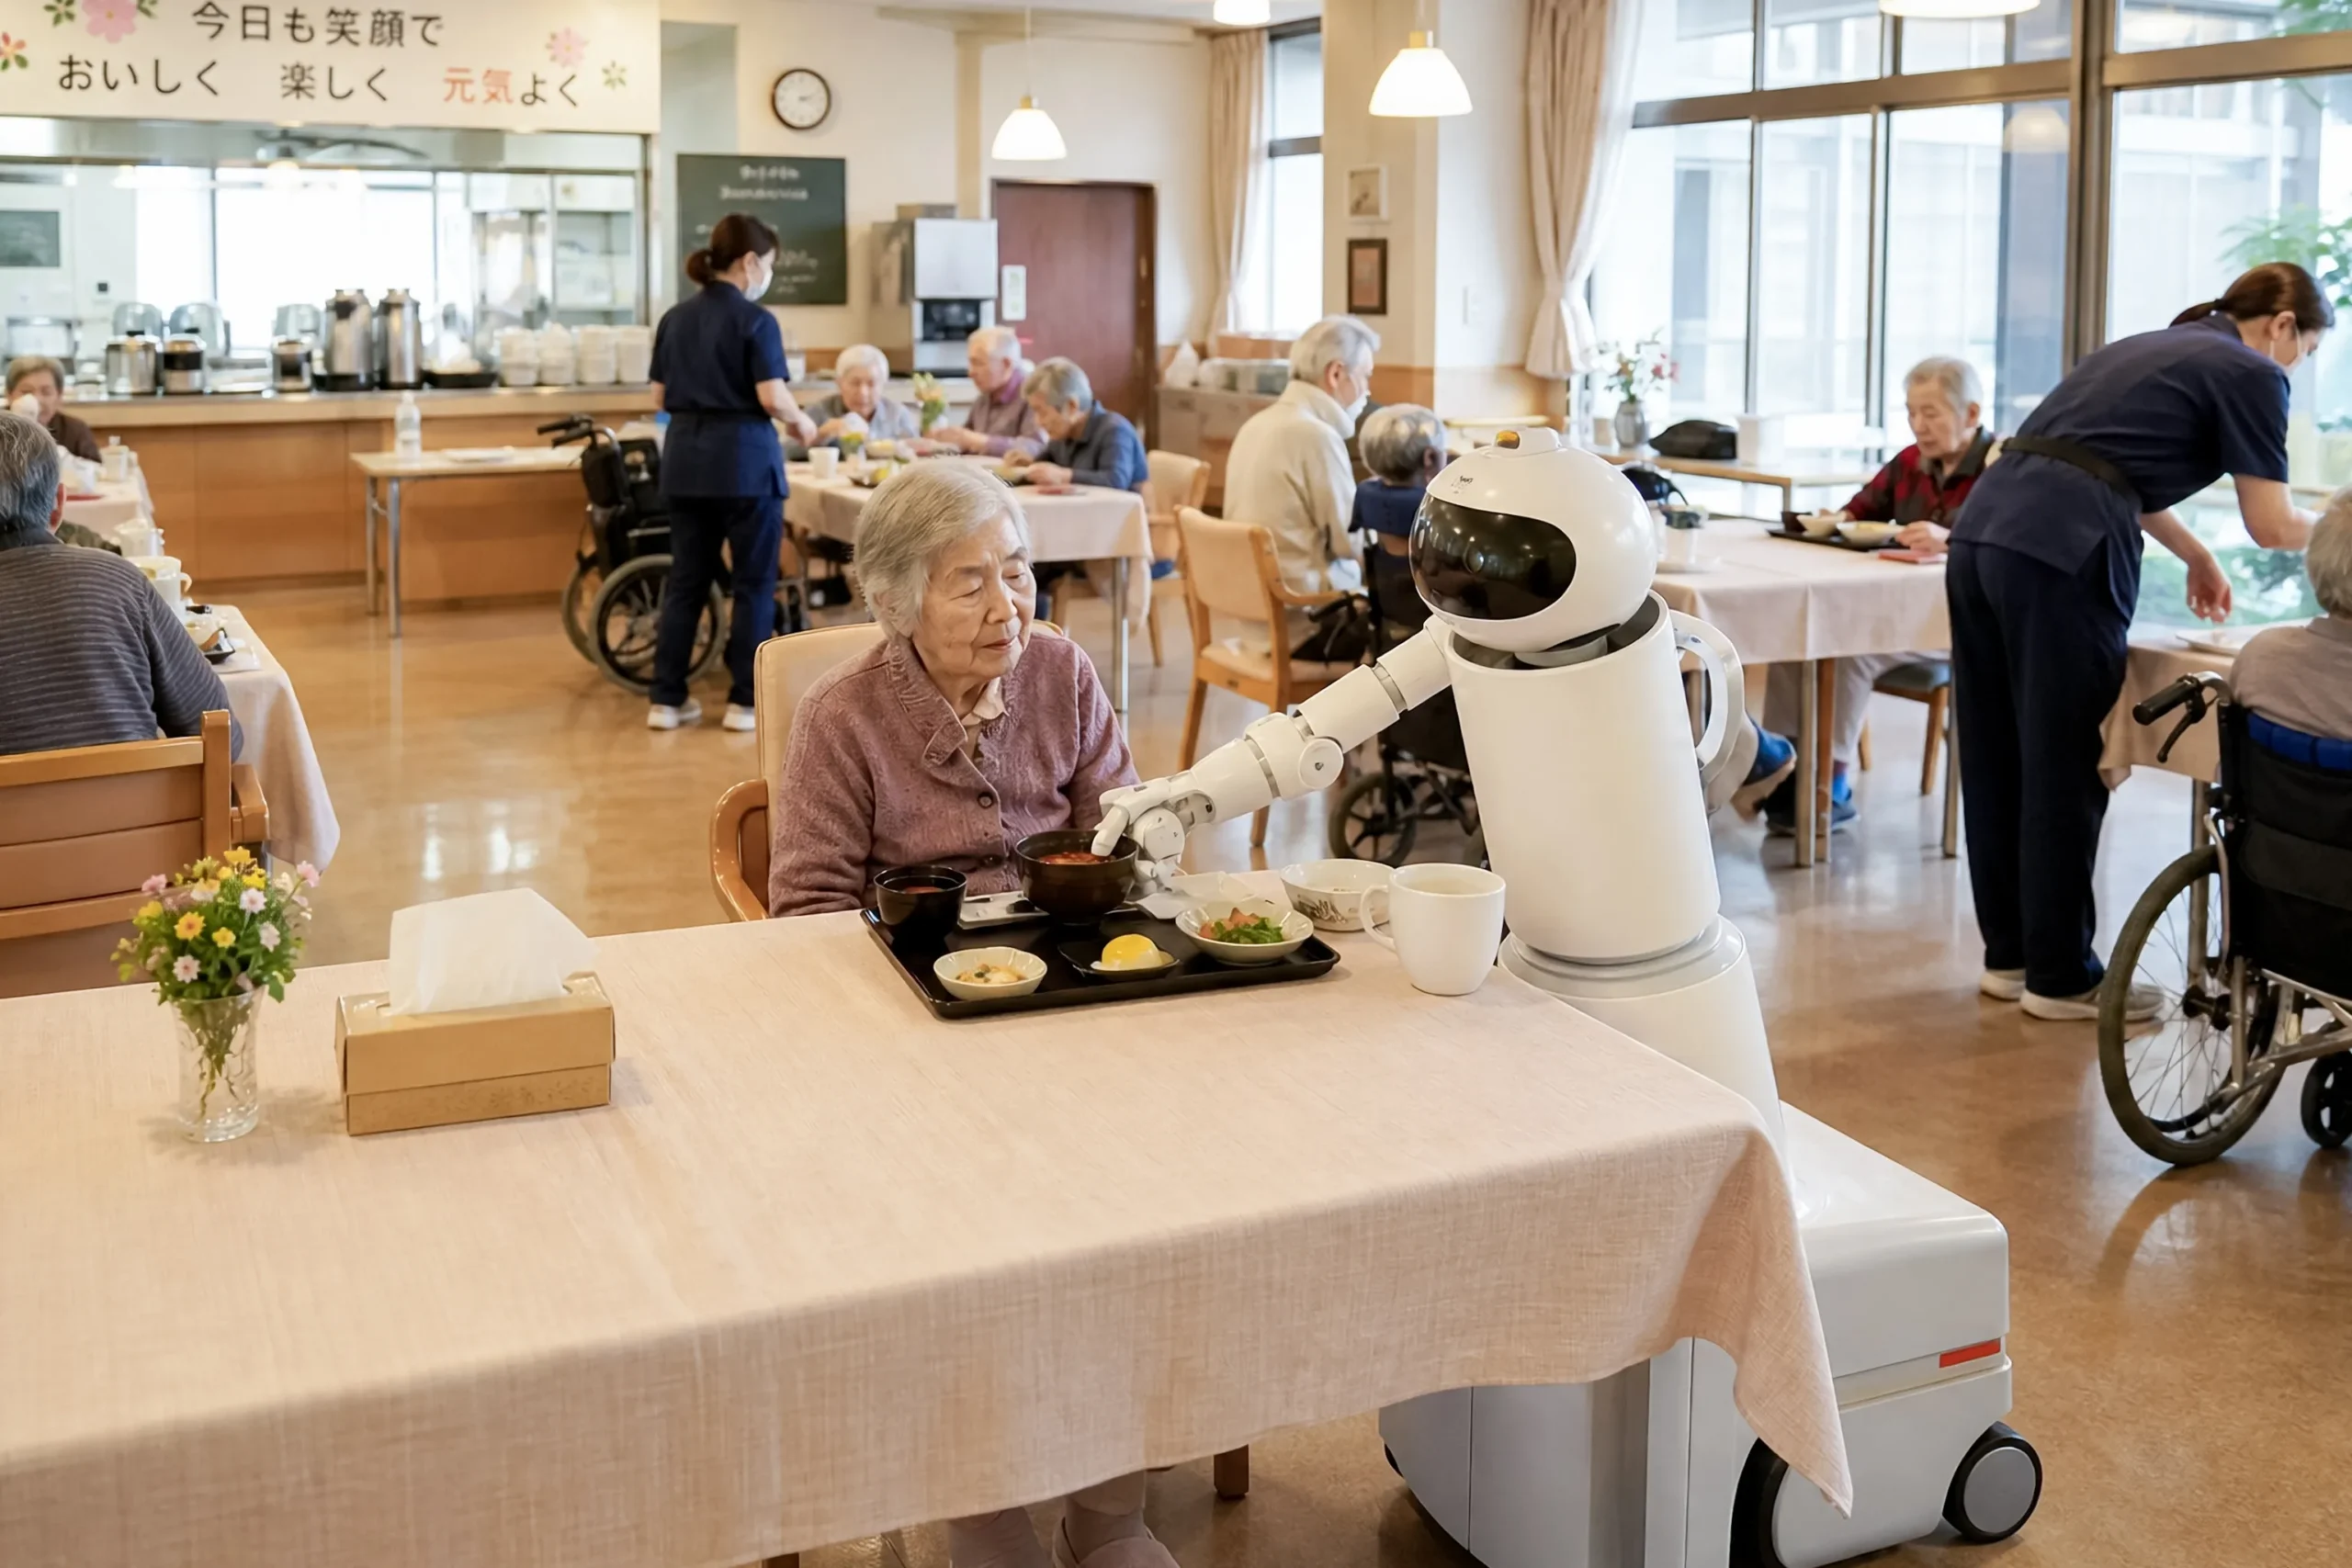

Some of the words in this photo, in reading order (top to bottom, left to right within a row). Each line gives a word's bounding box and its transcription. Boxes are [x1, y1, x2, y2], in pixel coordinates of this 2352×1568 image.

[192, 1, 444, 47] 今日も笑顔で
[59, 54, 219, 96] おいしく
[280, 61, 388, 101] 楽しく
[443, 67, 578, 107] 元気よく
